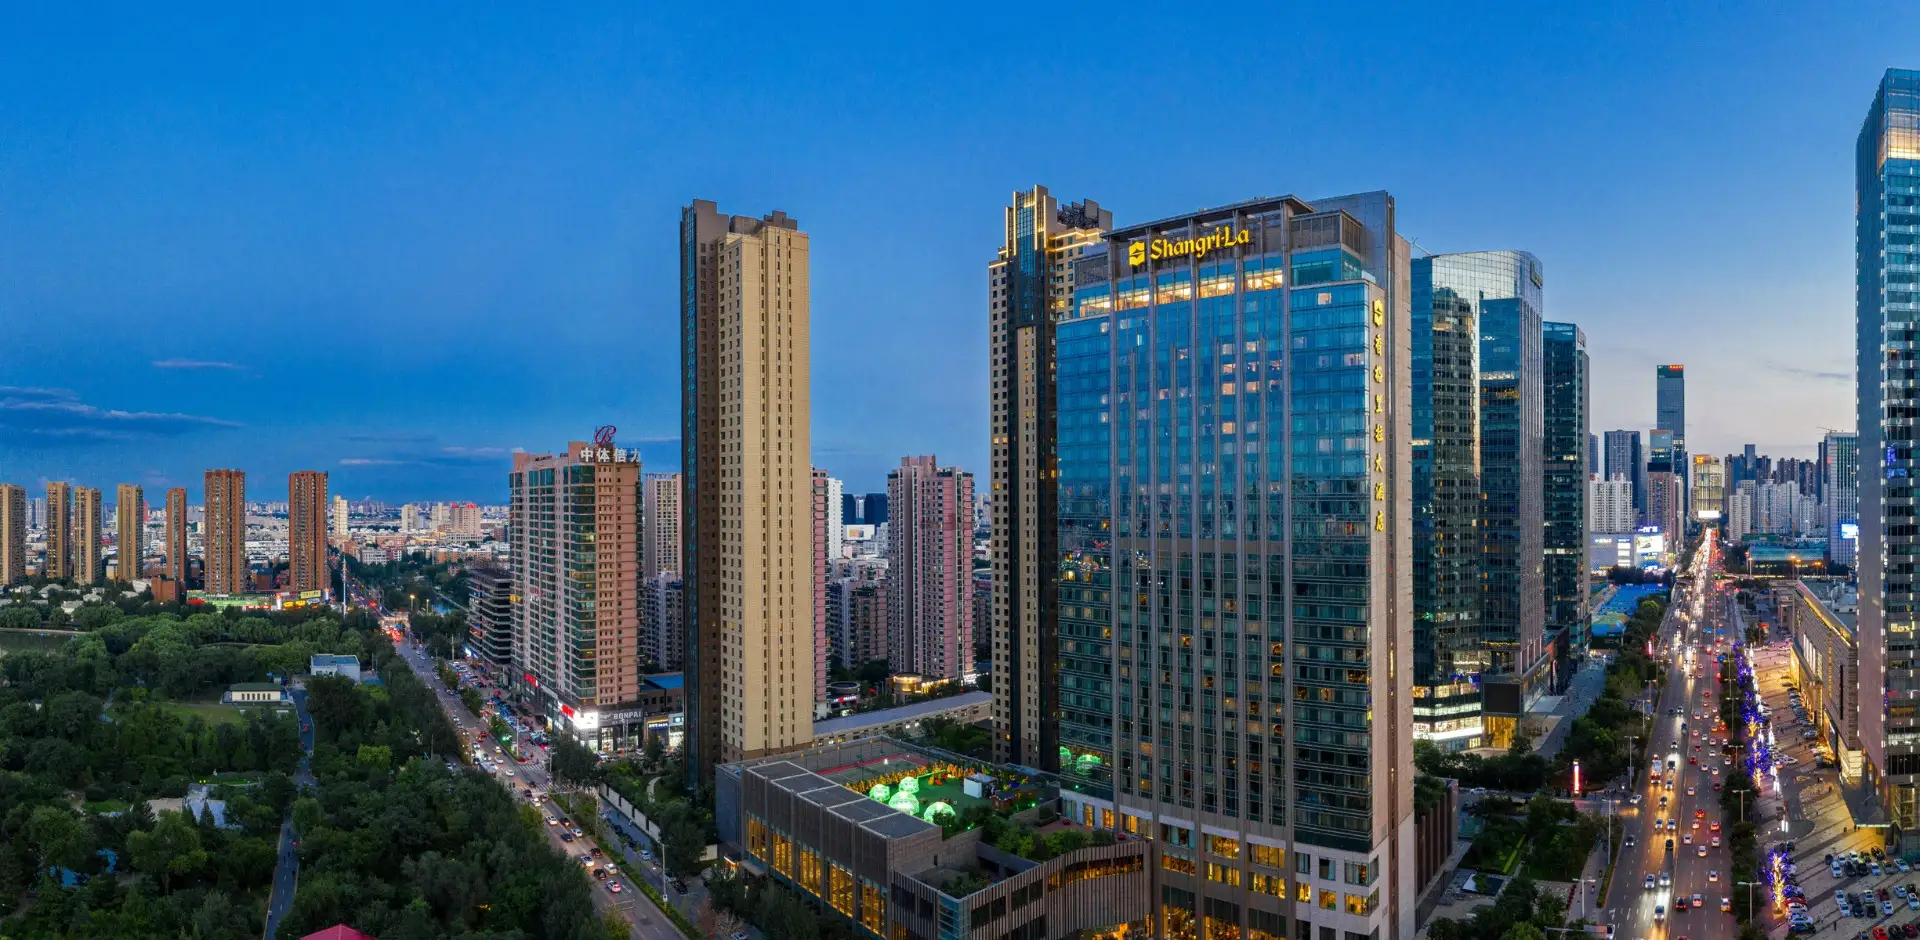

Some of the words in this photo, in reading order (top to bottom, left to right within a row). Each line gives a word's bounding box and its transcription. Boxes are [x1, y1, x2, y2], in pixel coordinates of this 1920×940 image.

[1150, 226, 1249, 260] Shangri-La
[1373, 334, 1384, 532] 香格里拉大酒店
[580, 447, 640, 463] 中体倍力
